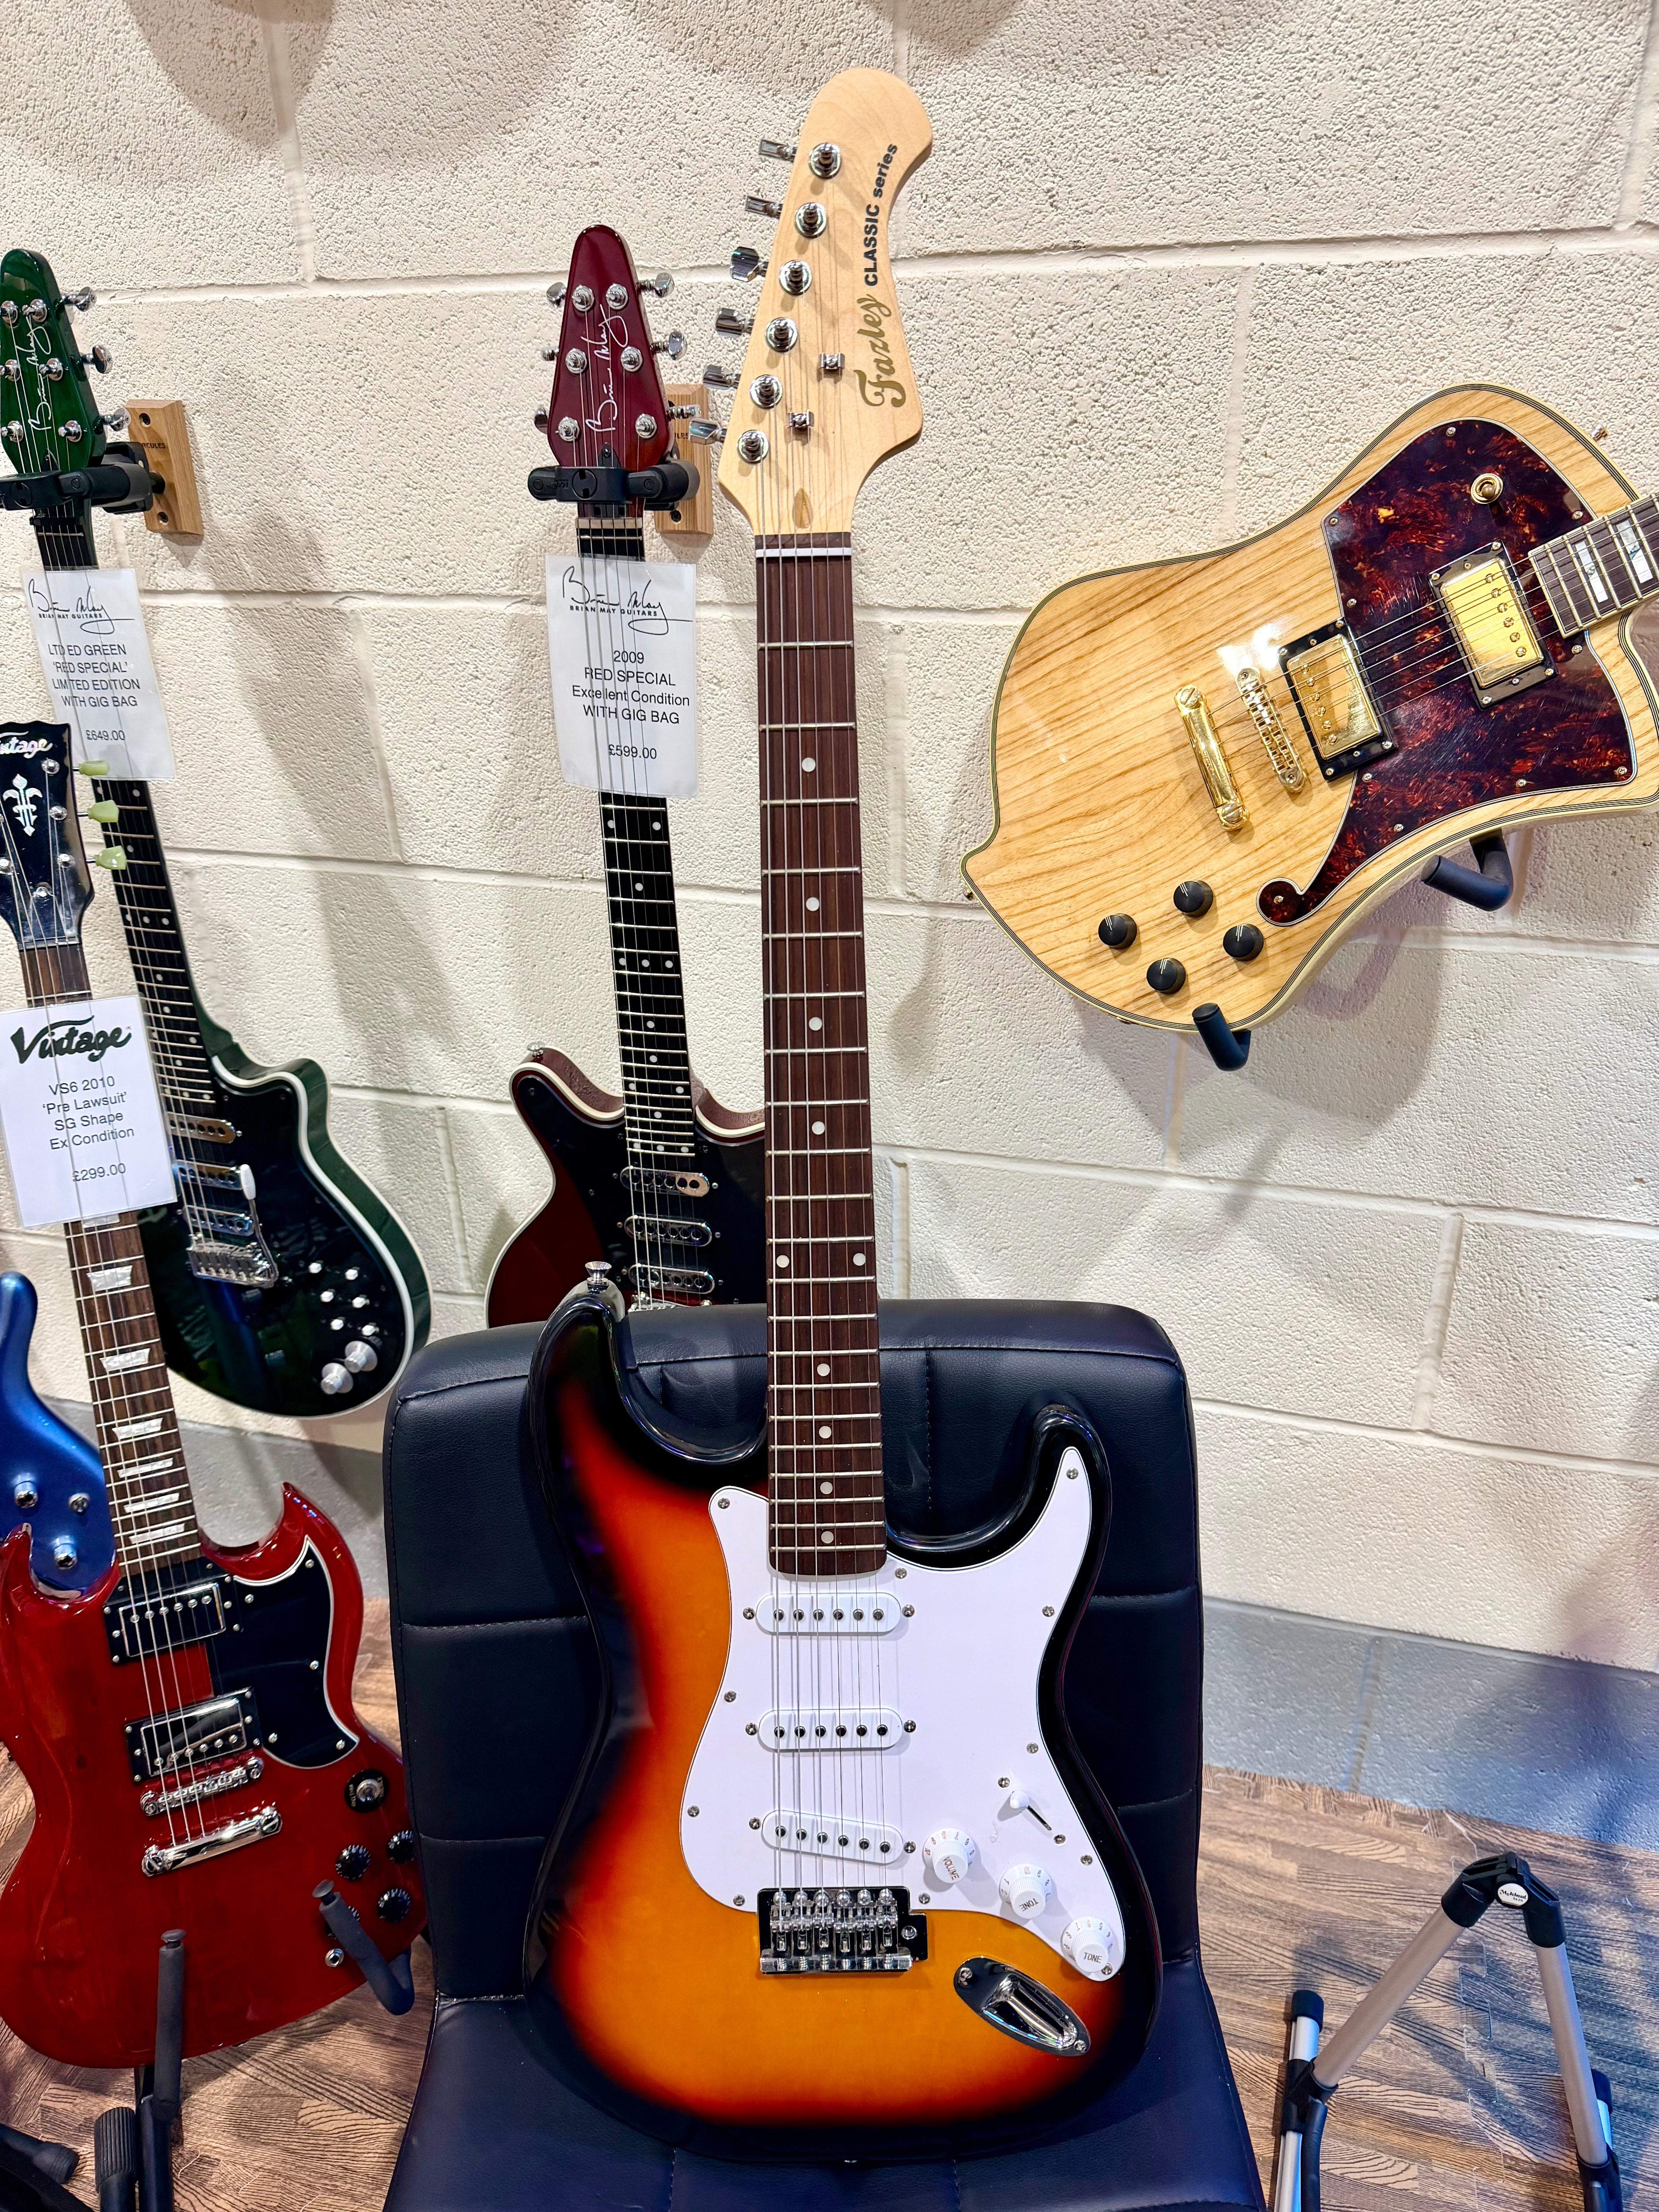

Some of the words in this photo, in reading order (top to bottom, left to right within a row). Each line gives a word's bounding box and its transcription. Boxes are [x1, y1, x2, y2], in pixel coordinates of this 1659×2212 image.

[864, 204, 879, 287] CLASSIC
[872, 143, 898, 198] series
[854, 294, 906, 408] Fazley
[48, 644, 65, 655] LTD
[67, 645, 81, 656] ED
[84, 644, 127, 656] GREEN
[613, 651, 644, 664] 2009
[92, 678, 141, 690] EDITION
[585, 667, 613, 681] RED
[617, 670, 676, 686] SPECIAL
[61, 696, 87, 707] WITH
[88, 696, 109, 707] GIG
[111, 696, 138, 707] BAG
[631, 690, 690, 706] Condition
[583, 704, 617, 719] WITH
[622, 708, 646, 721] GIG
[651, 710, 679, 724] BAG
[86, 729, 125, 741] £649.00
[608, 744, 657, 760] £599.00
[10, 1015, 132, 1064] Vintage
[48, 1082, 78, 1095] VS6
[82, 1076, 115, 1091] 2010
[54, 1118, 76, 1131] SG
[80, 1113, 124, 1127] Shape
[50, 1138, 69, 1150] Ex
[72, 1128, 135, 1146] Condition
[72, 1163, 127, 1182] £299.00
[943, 1856, 960, 1880] VOLUME
[1019, 1898, 1039, 1912] TONE
[1083, 1952, 1103, 1963] TONE
